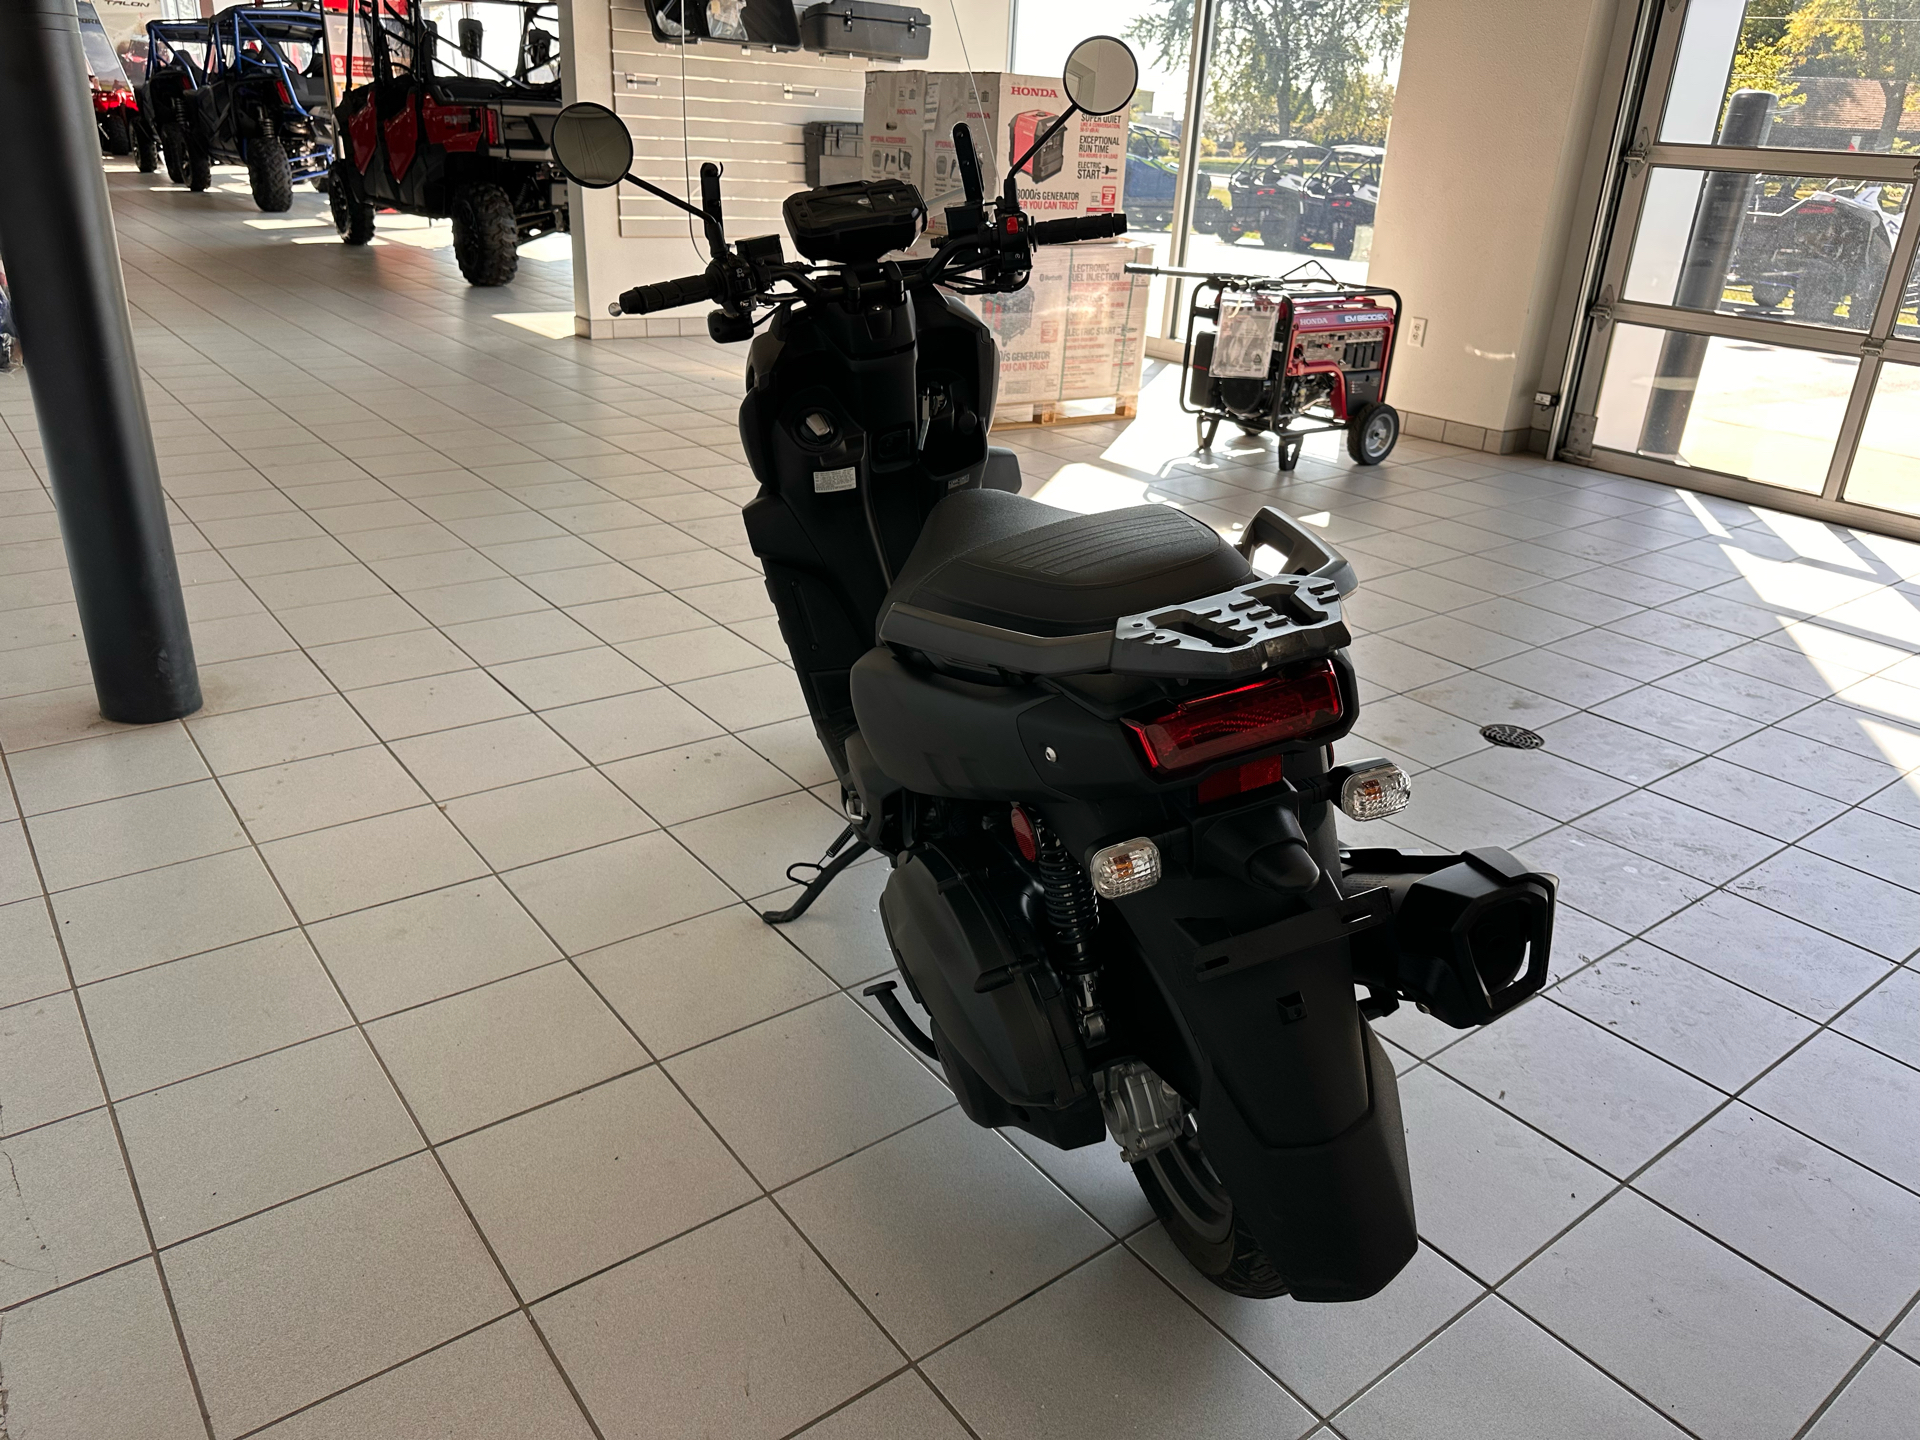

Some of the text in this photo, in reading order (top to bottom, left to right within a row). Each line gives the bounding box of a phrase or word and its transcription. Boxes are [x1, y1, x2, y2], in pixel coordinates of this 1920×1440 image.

[105, 0, 150, 8] TALON
[1011, 86, 1058, 98] HONDA
[1103, 115, 1121, 124] QUIET
[869, 135, 884, 143] OPTIONAL
[1079, 135, 1120, 146] EXCEPTIONAL
[1079, 145, 1110, 154] RUN TIME
[1077, 161, 1102, 169] ELECTRIC
[1077, 169, 1101, 180] START
[1042, 191, 1080, 201] GENERATOR
[1028, 201, 1043, 210] YOU
[1043, 201, 1058, 210] CAN
[1058, 201, 1079, 211] TRUST
[1086, 272, 1121, 282] INJECTION
[1299, 317, 1329, 326] HONDA
[1095, 326, 1117, 336] START
[1011, 351, 1051, 362] GENERATOR
[1012, 362, 1027, 371] CAN
[1028, 361, 1050, 371] TRUST
